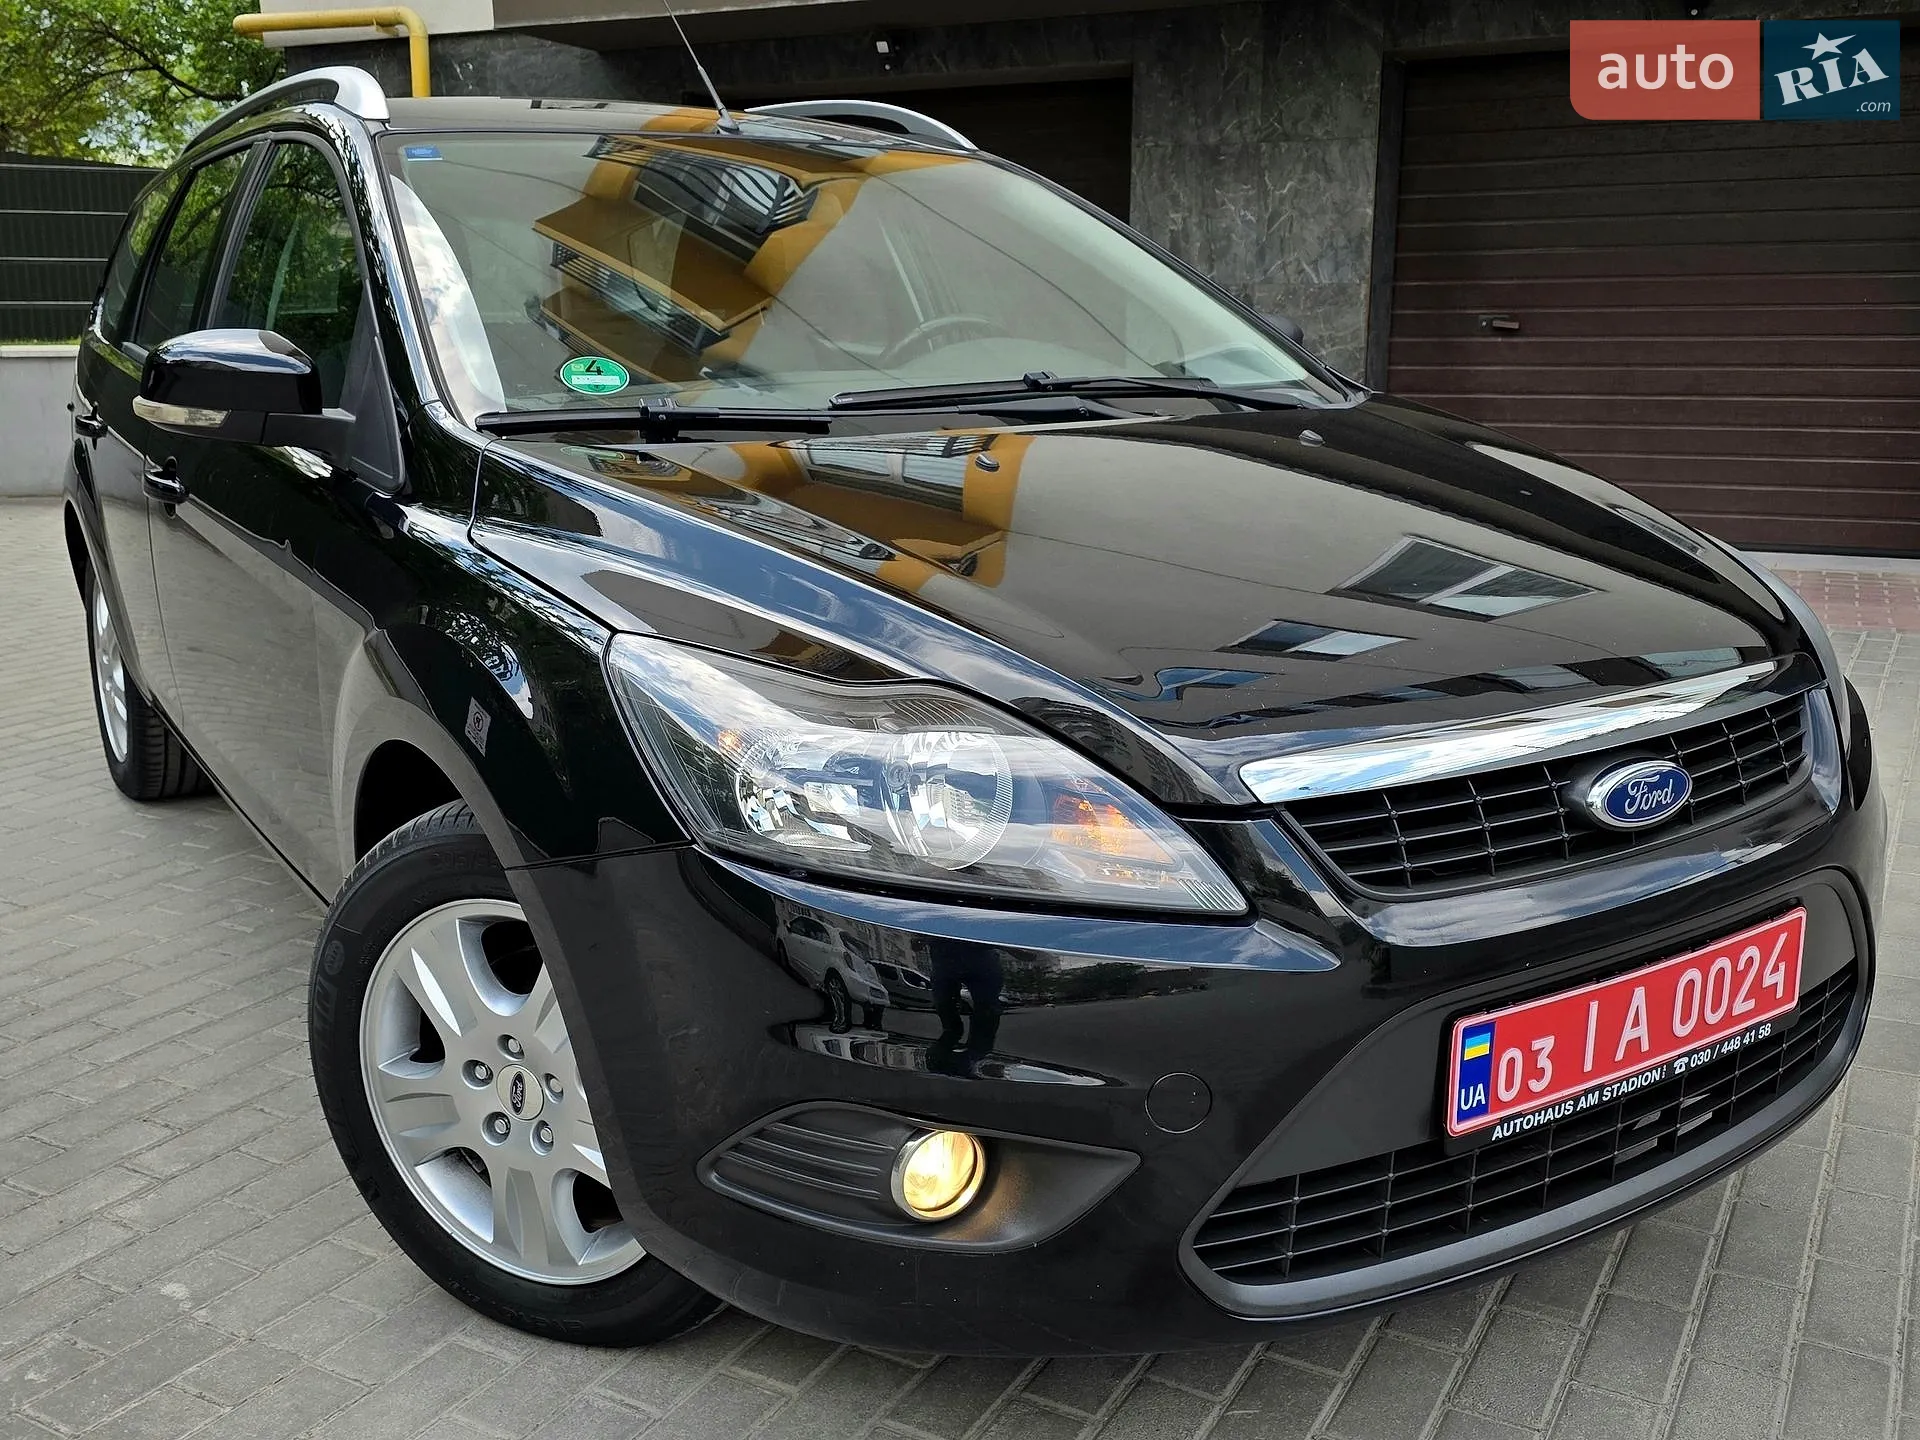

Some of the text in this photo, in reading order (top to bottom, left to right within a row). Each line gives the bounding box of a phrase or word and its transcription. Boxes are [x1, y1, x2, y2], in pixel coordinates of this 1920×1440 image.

[585, 359, 604, 376] 4
[1624, 774, 1675, 815] Ford
[1497, 931, 1788, 1103] 03 IA 0024
[512, 1080, 523, 1108] Ford
[1460, 1083, 1486, 1111] UA
[1491, 1100, 1575, 1141] AUTOHAUS
[1576, 1090, 1600, 1112] AM
[1602, 1068, 1661, 1101] STADION
[1690, 1048, 1711, 1068] 030
[1712, 1044, 1719, 1059] /
[1720, 1036, 1741, 1055] 448
[1742, 1029, 1756, 1045] 41
[1758, 1022, 1772, 1039] 58
